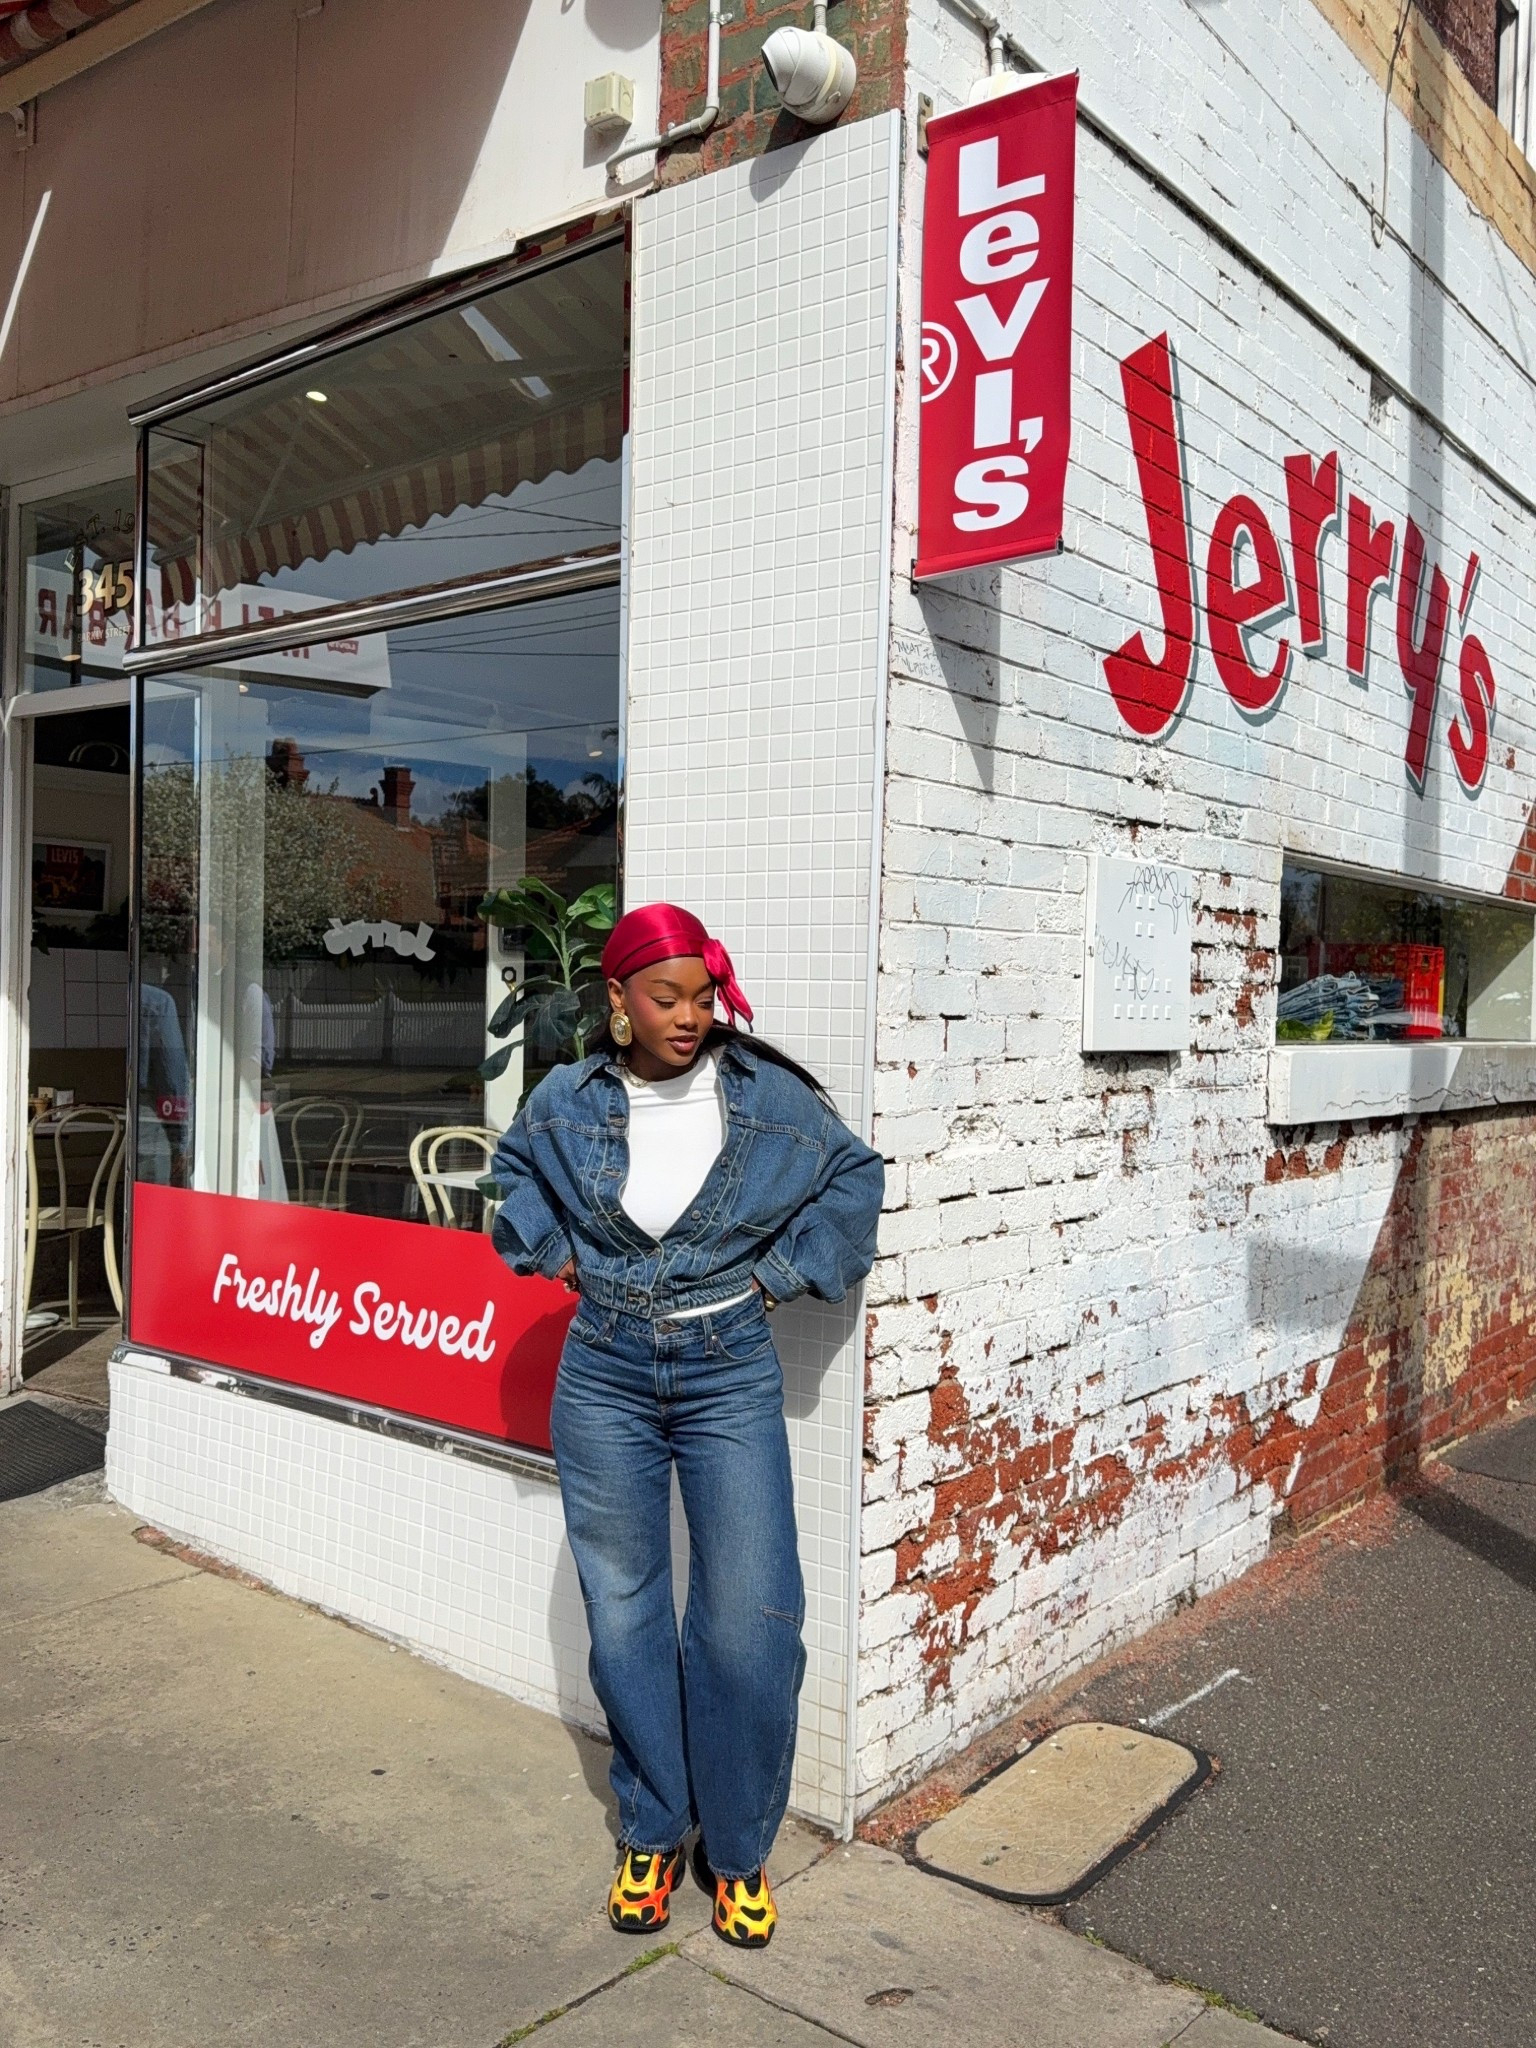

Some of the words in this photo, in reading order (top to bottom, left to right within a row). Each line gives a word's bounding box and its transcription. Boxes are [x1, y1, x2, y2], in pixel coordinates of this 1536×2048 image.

[952, 136, 1051, 532] Levi's
[78, 560, 134, 616] 345
[1102, 330, 1496, 796] Jerry's
[213, 1253, 342, 1349] Freshly
[349, 1281, 496, 1362] Served
